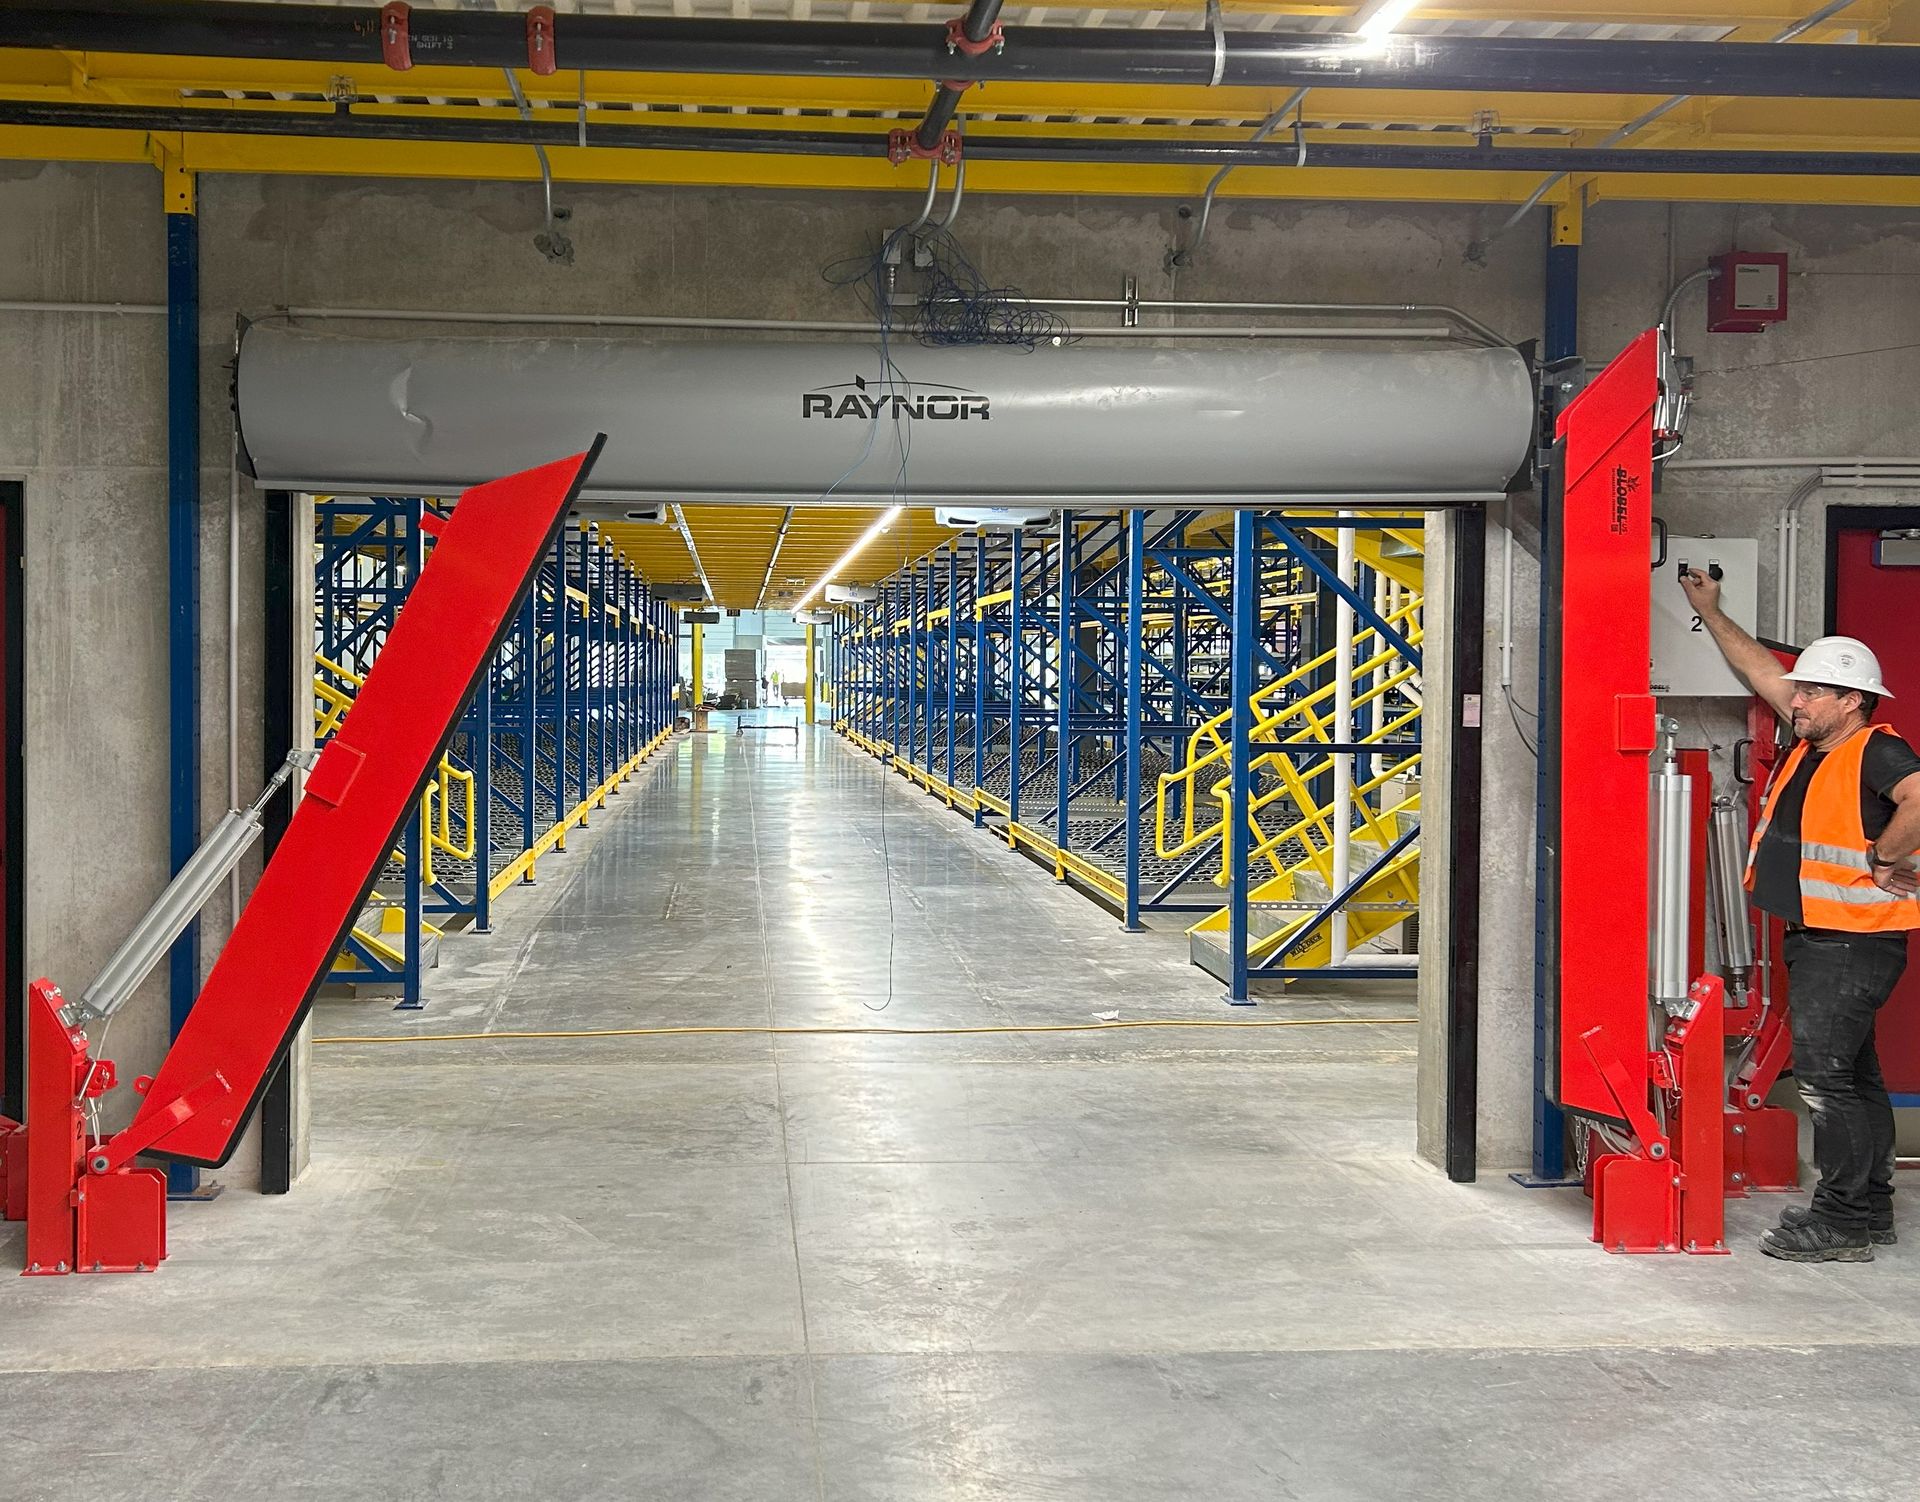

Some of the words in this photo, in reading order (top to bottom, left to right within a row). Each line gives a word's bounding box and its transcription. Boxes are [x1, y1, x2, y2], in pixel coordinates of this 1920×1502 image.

[802, 393, 991, 420] RAYNOR
[1616, 468, 1628, 523] BLOBEL
[1691, 615, 1703, 632] 2
[76, 1120, 82, 1141] 2
